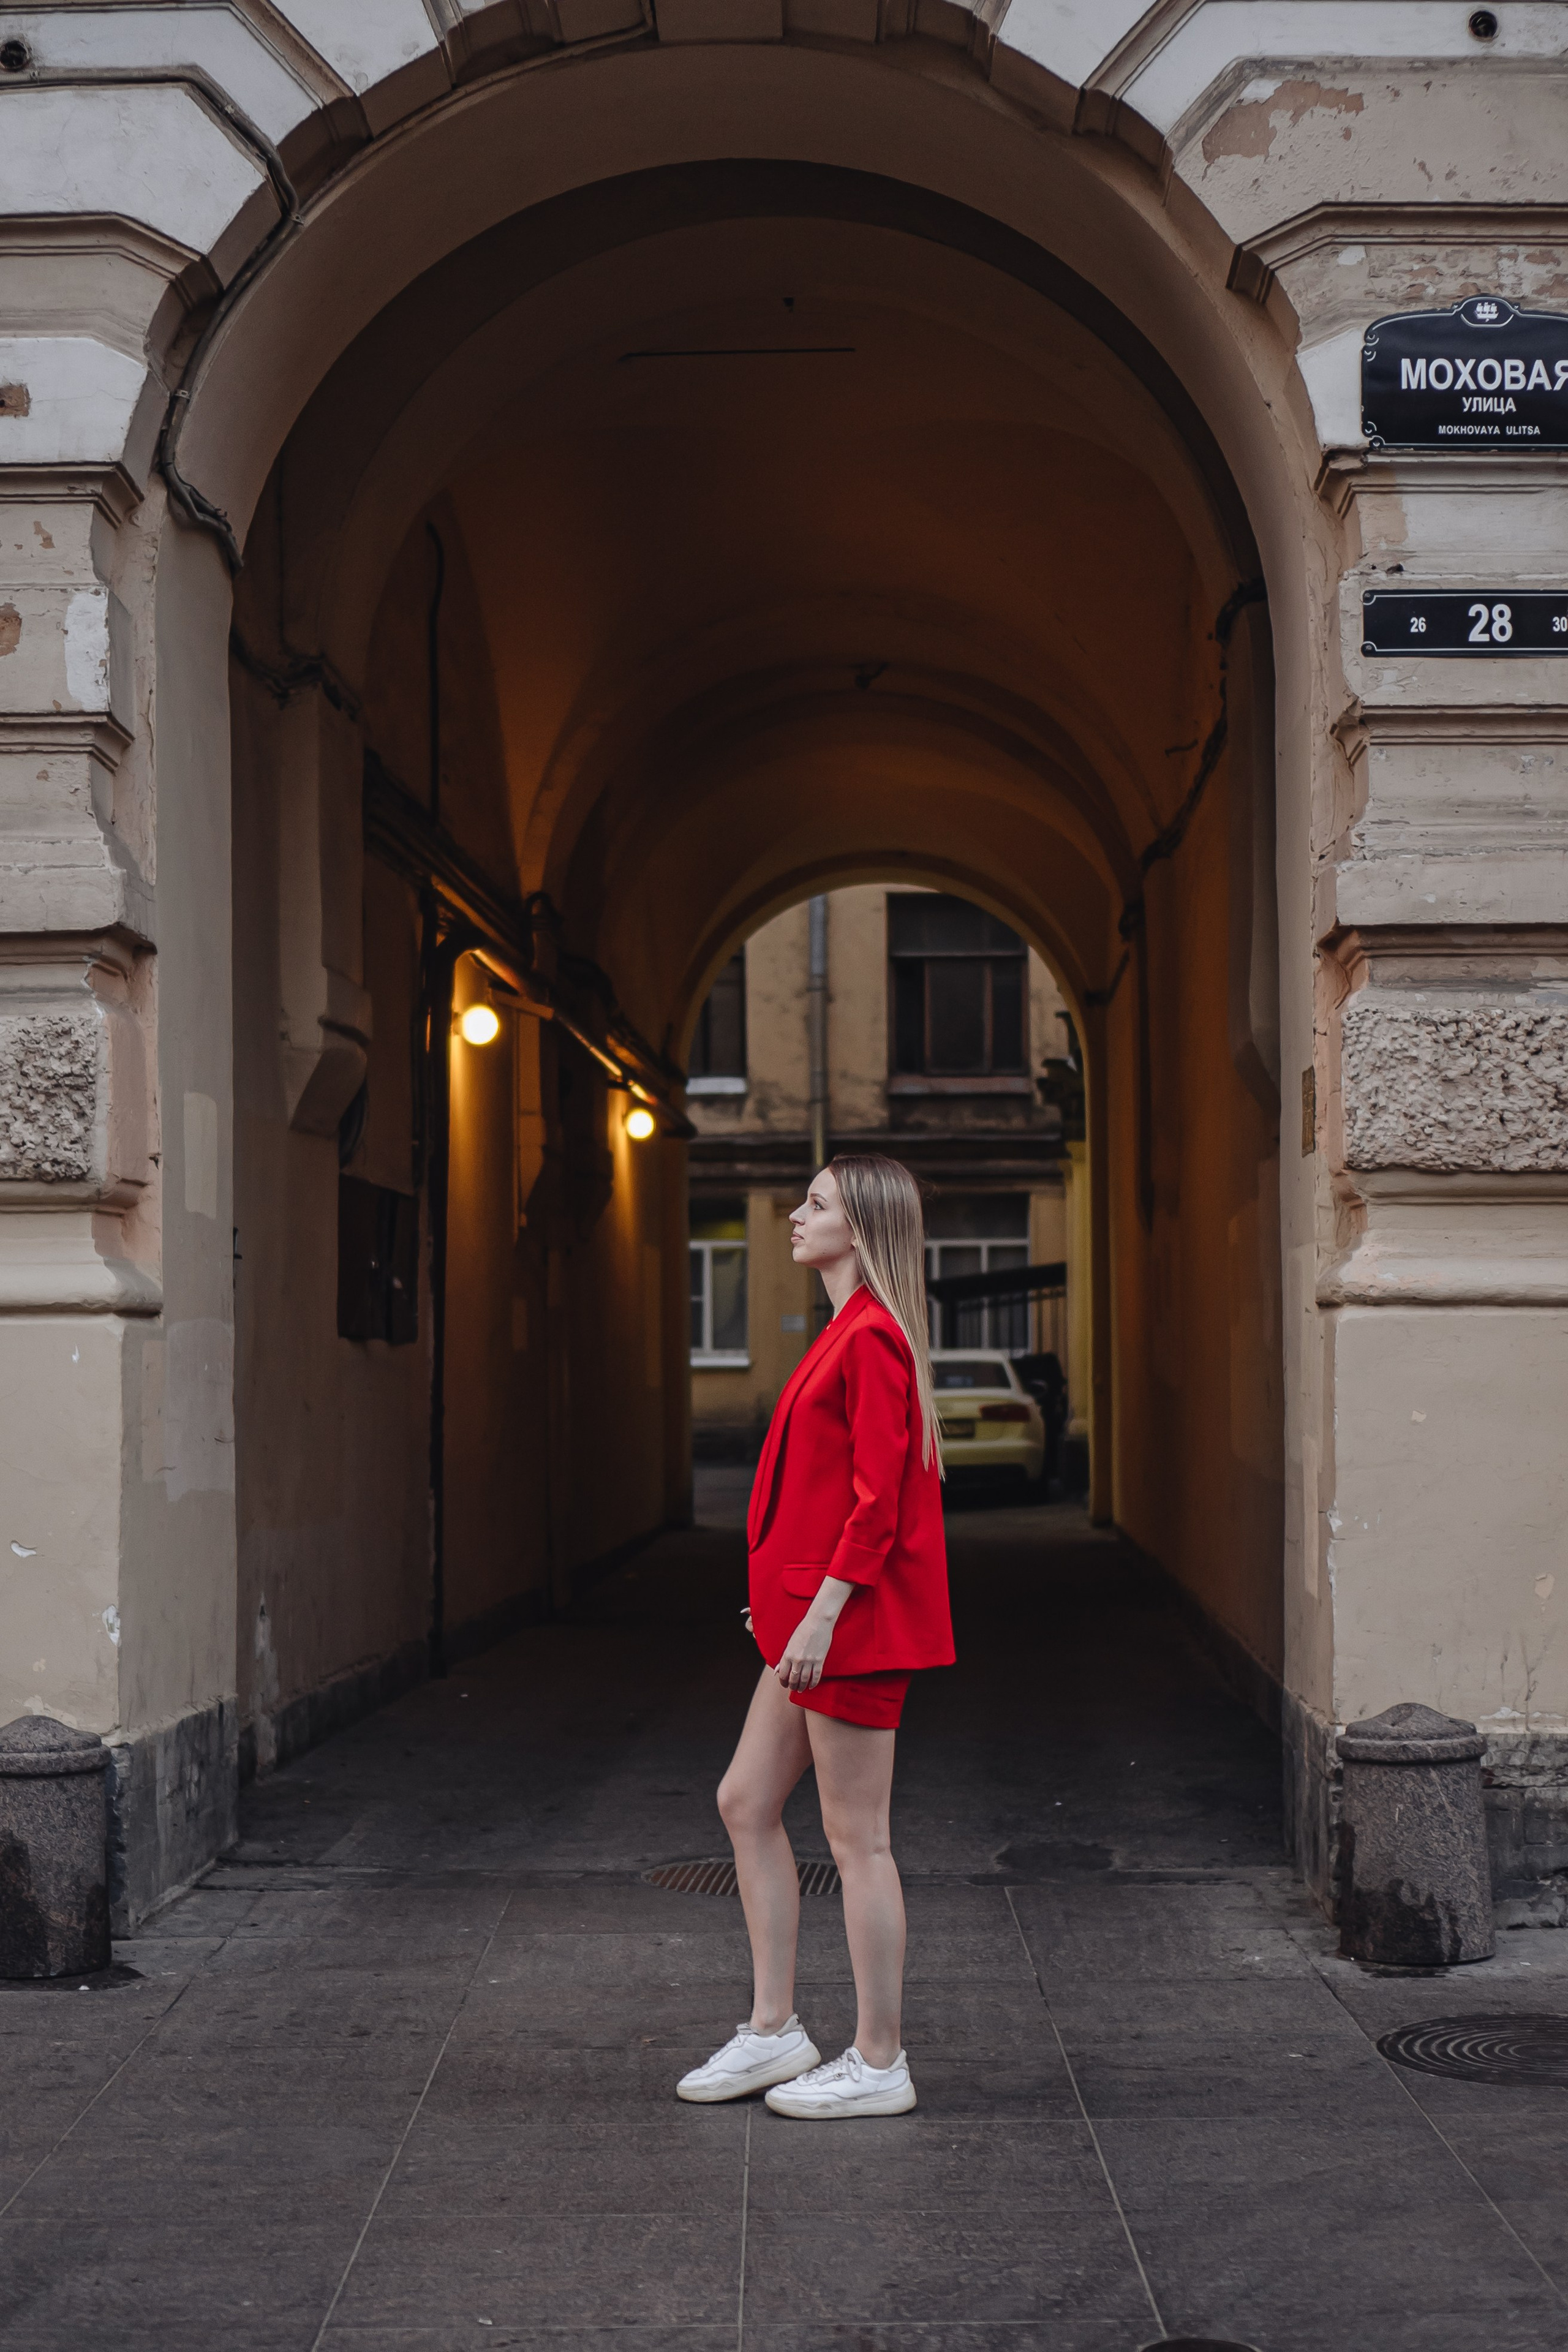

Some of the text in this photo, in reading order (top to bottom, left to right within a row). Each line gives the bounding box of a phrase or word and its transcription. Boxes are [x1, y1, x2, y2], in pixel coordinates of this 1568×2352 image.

[1400, 358, 1568, 391] МОХОВАЯ
[1462, 396, 1517, 415] УЛИЦА
[1438, 425, 1541, 435] MOKHOVAYA ULITSA
[1410, 603, 1568, 643] 26 28 30
